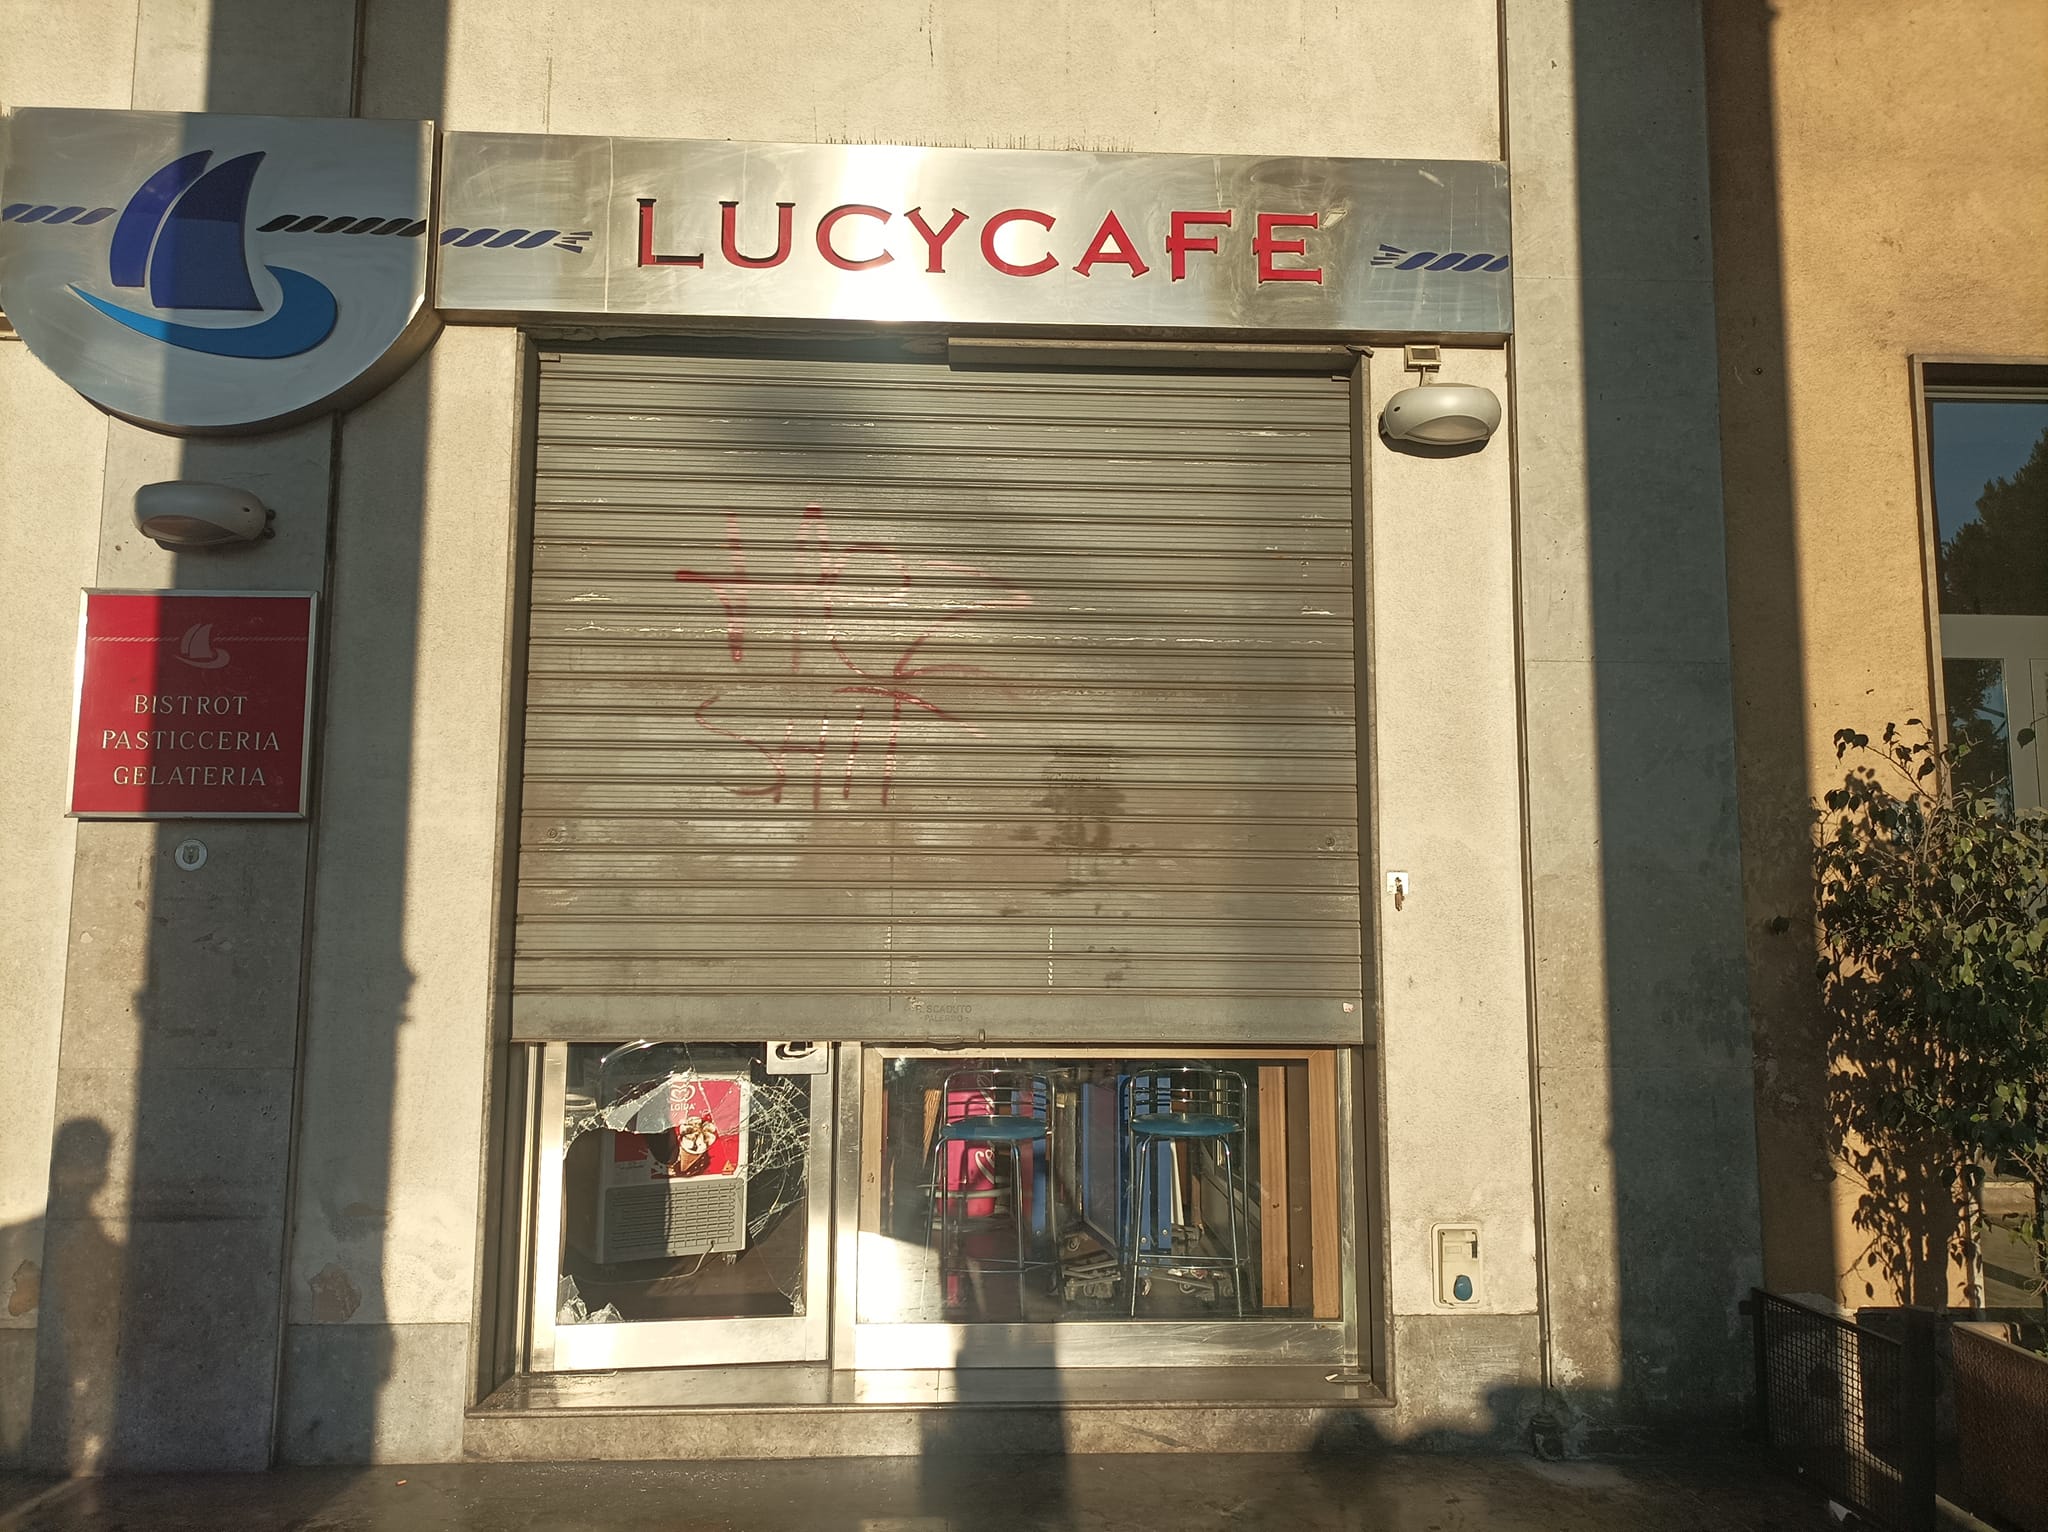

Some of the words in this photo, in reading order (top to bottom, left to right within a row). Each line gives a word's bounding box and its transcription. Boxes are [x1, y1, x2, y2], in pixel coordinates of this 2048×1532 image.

[134, 694, 248, 715] BISTROT
[101, 729, 280, 751] PASTICCERIA
[113, 766, 267, 787] GELATERIA
